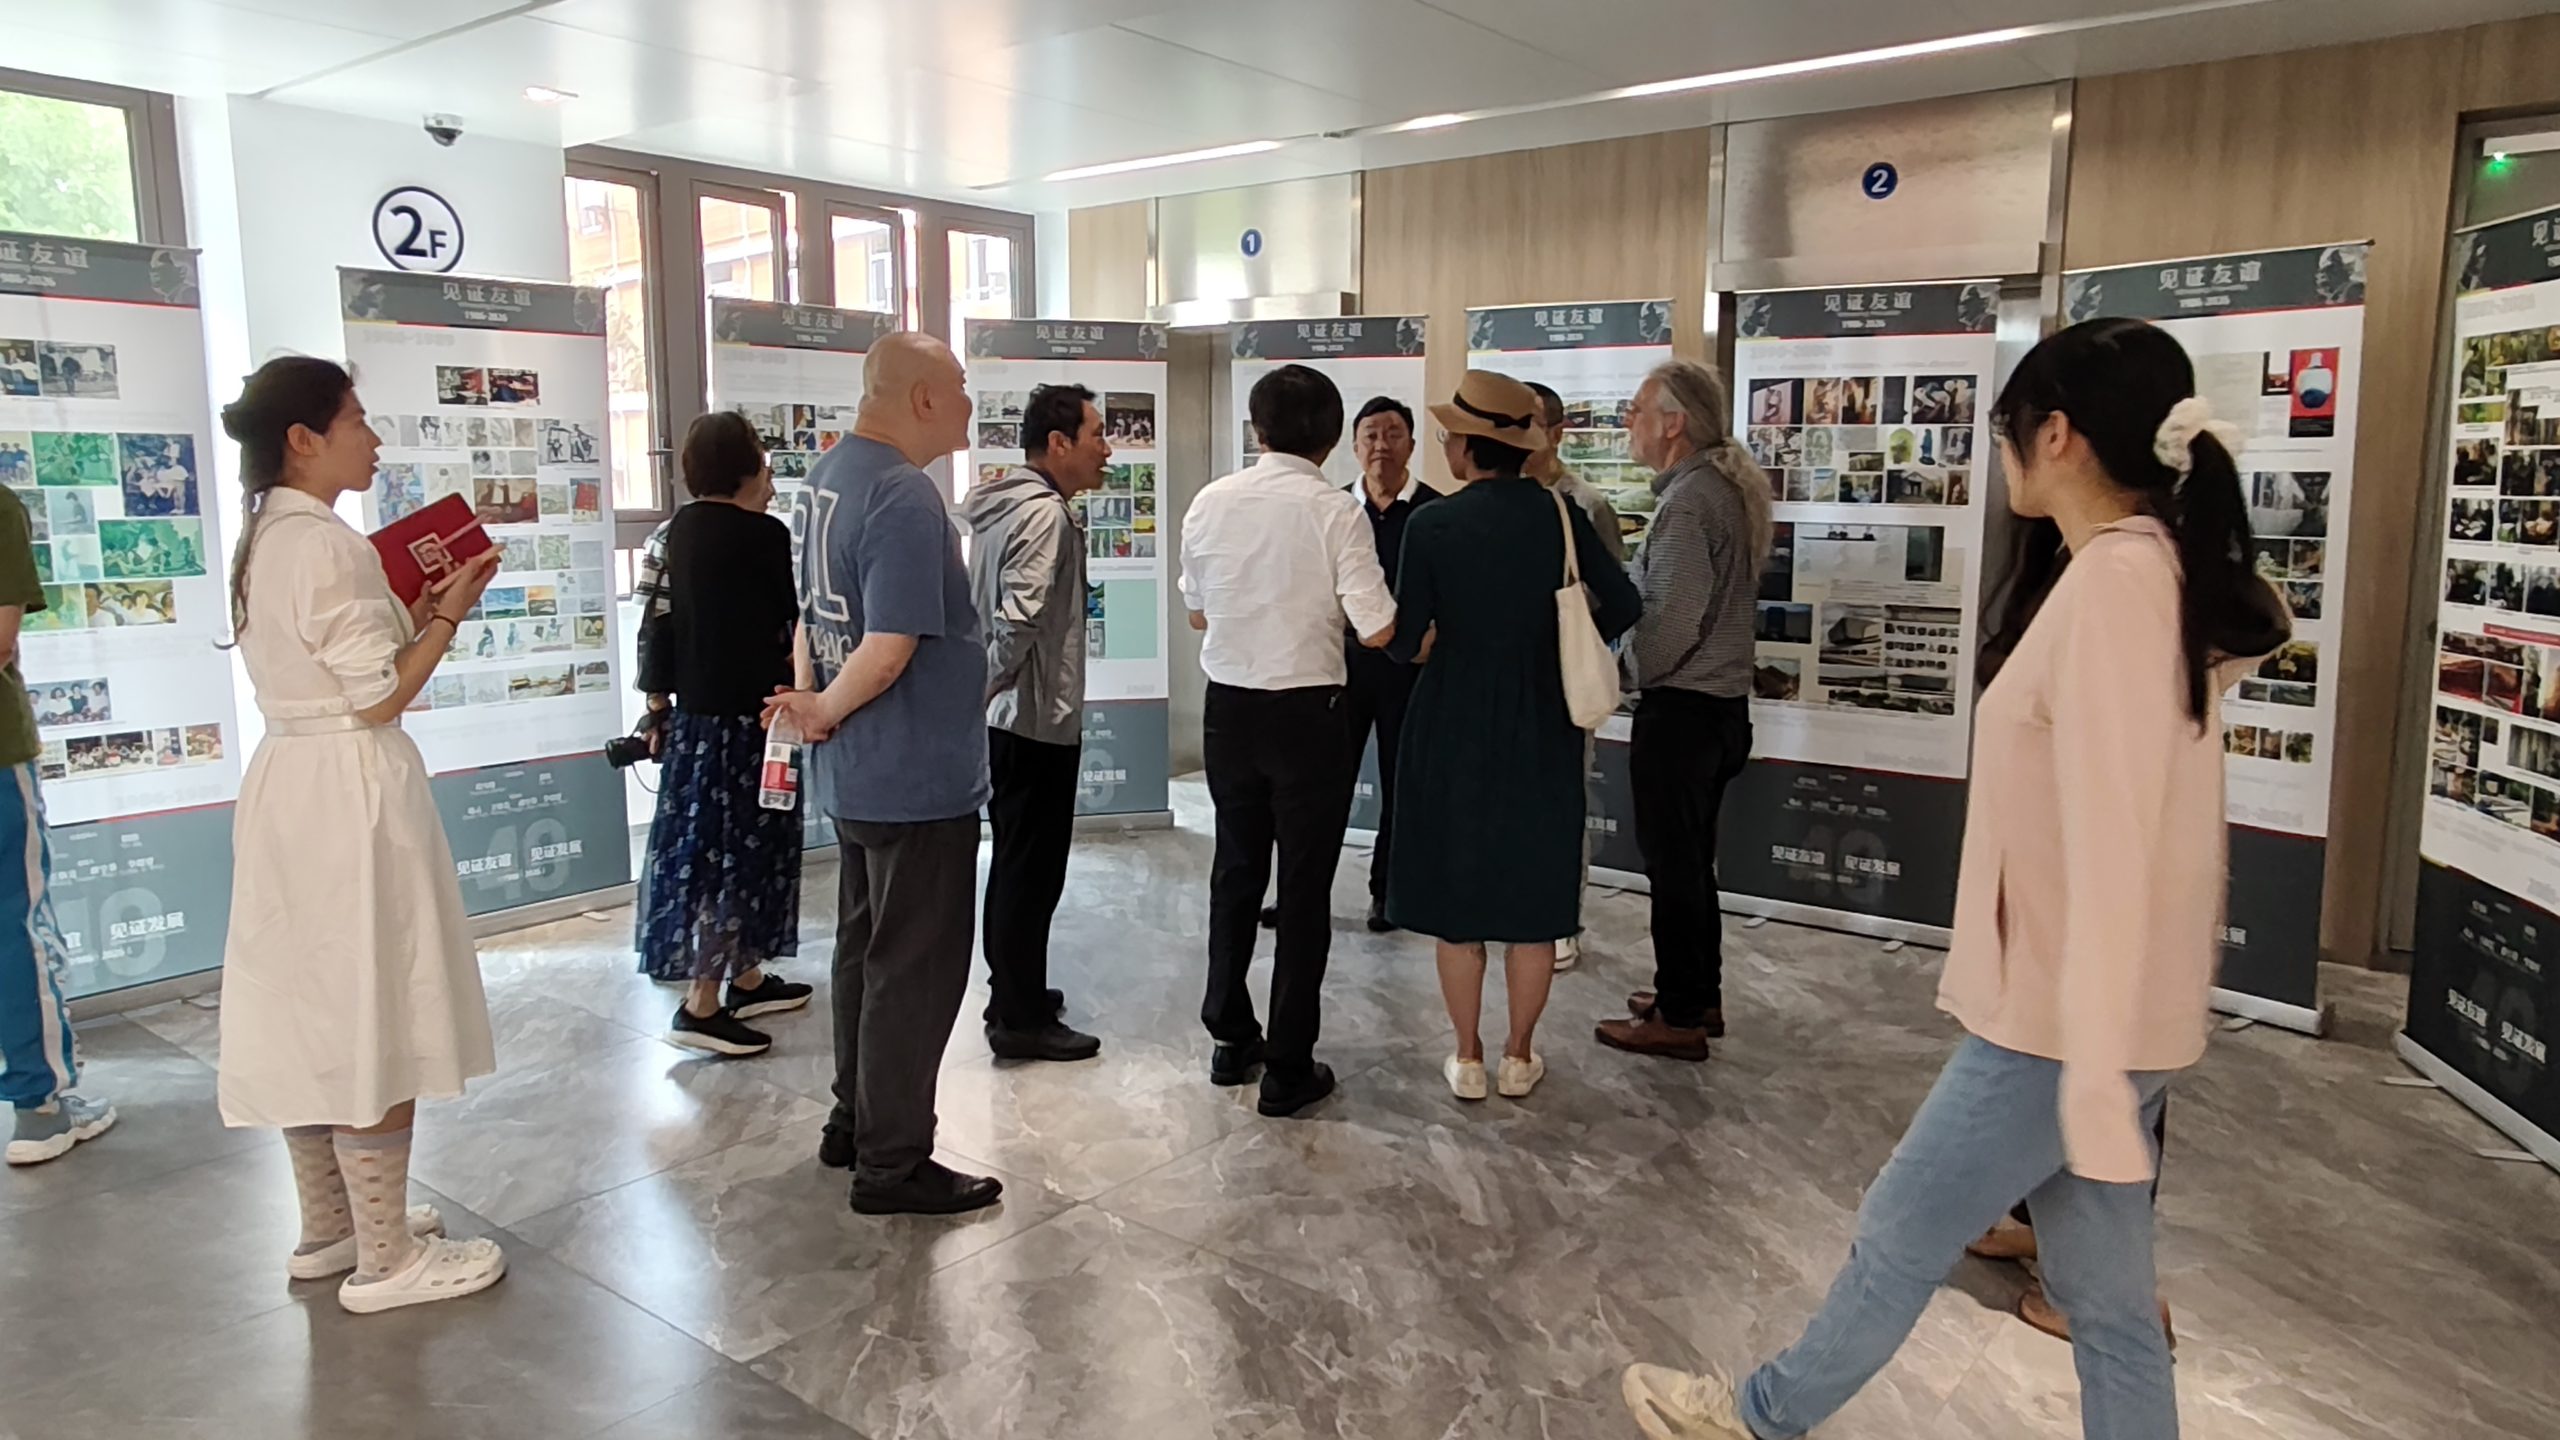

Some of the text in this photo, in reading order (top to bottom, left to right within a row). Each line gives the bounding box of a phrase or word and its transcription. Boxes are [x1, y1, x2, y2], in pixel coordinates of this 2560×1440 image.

[1871, 169, 1888, 193] 2
[389, 205, 447, 259] 2F
[1246, 233, 1255, 252] 1
[2158, 261, 2263, 291] 见证友谊
[443, 282, 532, 306] 见证友谊
[1824, 292, 1912, 312] 见证友谊
[781, 308, 844, 329] 见证友谊
[1534, 308, 1604, 327] 见证友谊
[1036, 325, 1104, 340] 见证友谊
[1297, 322, 1363, 339] 见证友谊
[531, 840, 581, 862] 见证发展
[109, 911, 184, 940] 见证发展
